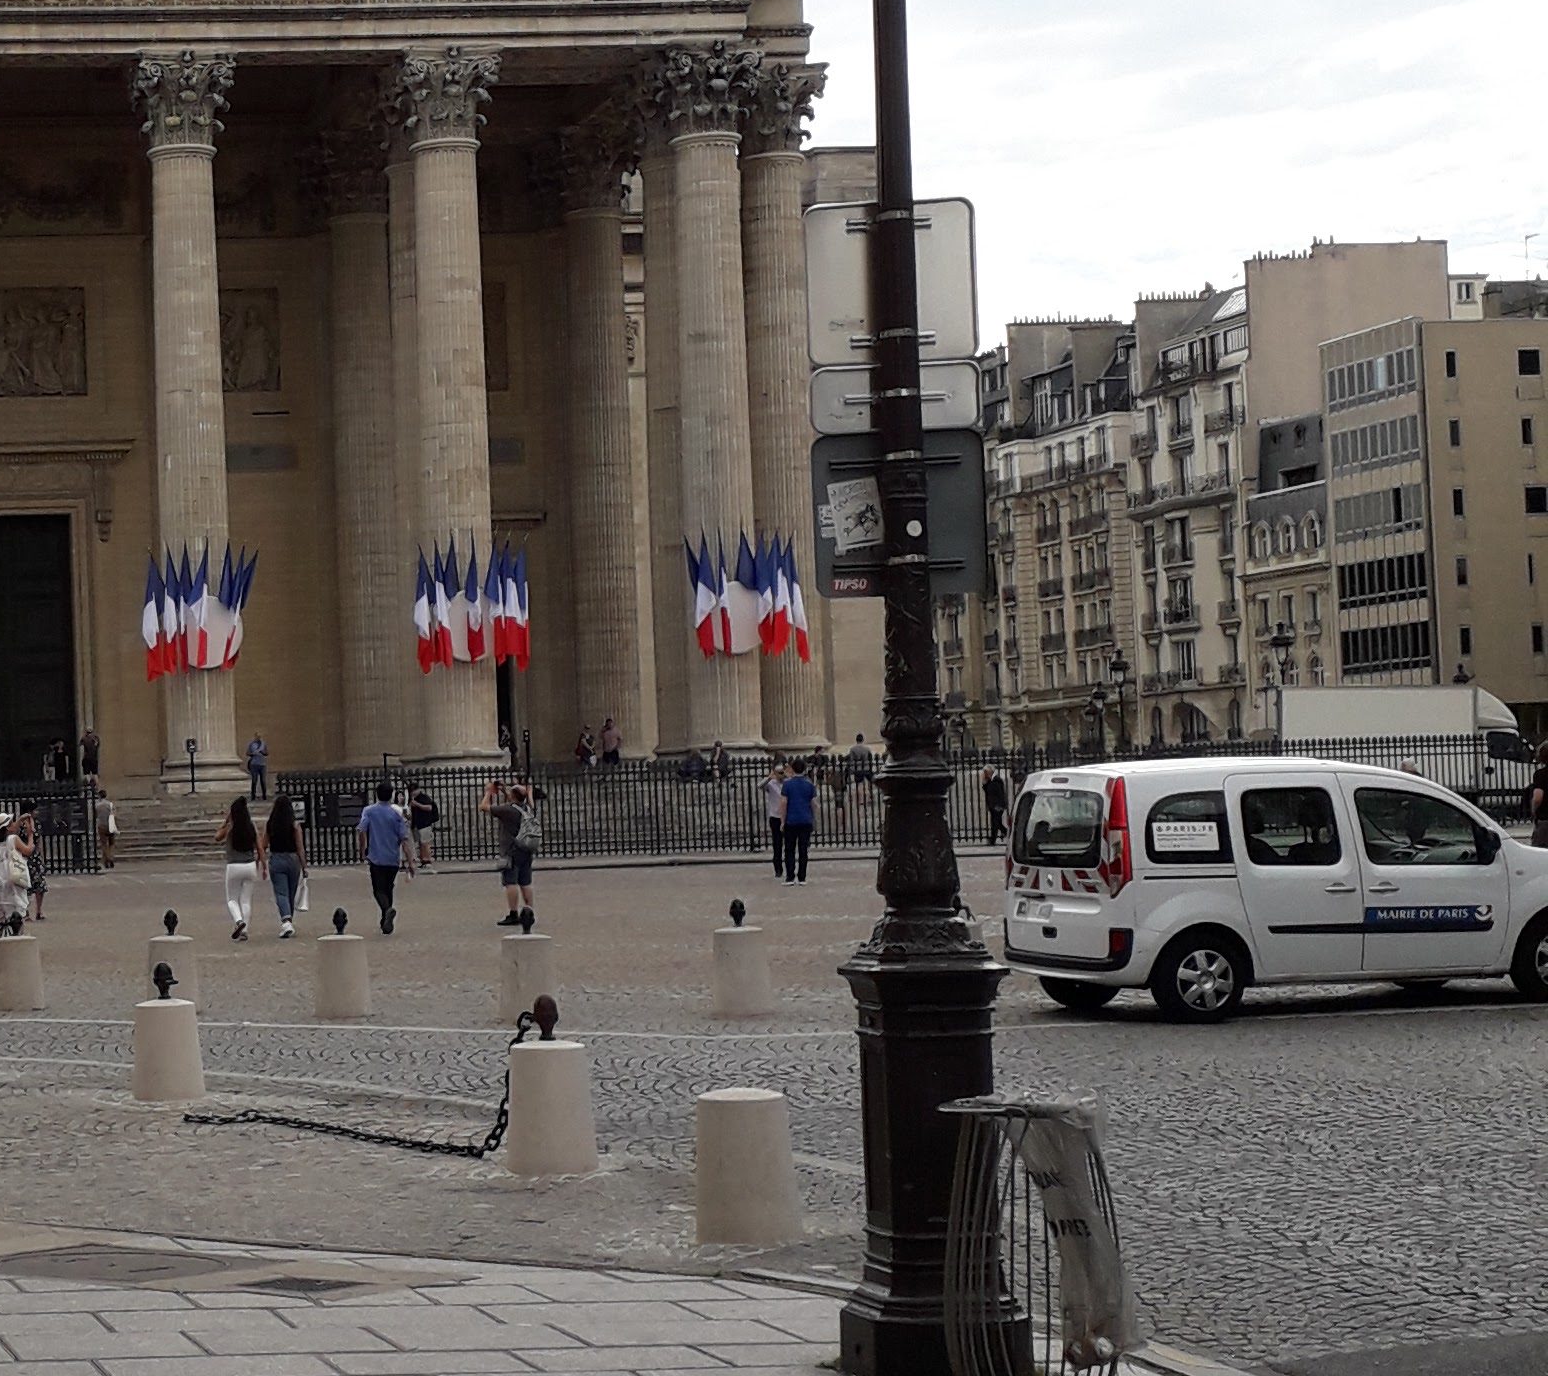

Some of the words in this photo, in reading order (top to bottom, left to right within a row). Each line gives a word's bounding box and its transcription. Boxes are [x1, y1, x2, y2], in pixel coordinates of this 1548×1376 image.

[833, 578, 868, 591] TIPSO
[1377, 909, 1415, 919] MAIRIE
[1419, 910, 1435, 919] DE
[1437, 908, 1469, 918] PARIS
